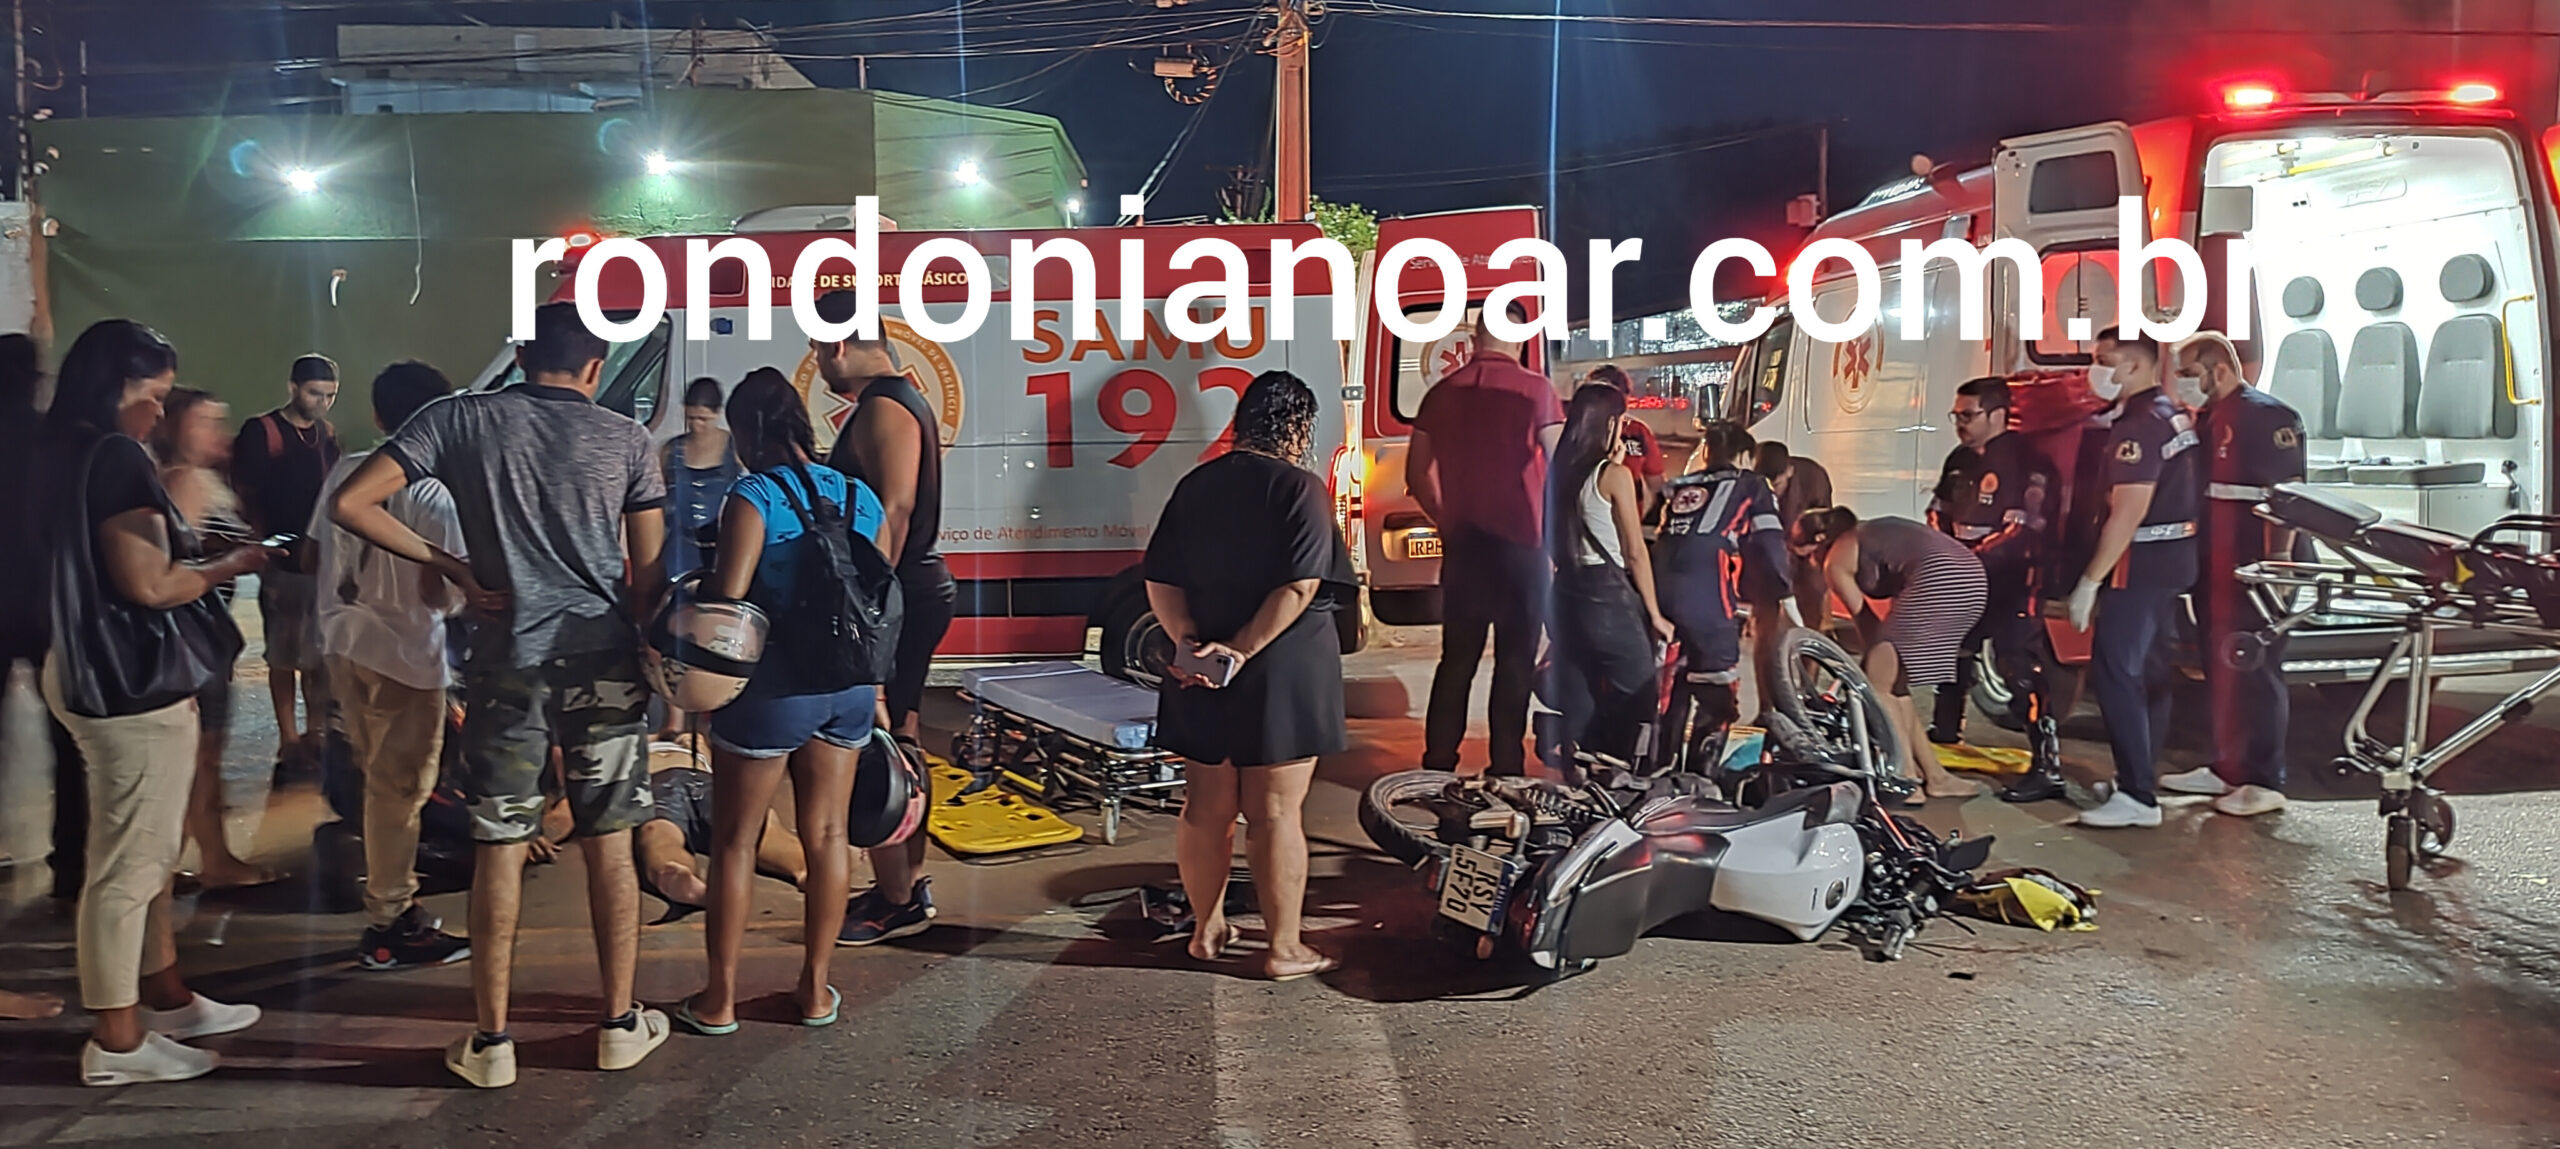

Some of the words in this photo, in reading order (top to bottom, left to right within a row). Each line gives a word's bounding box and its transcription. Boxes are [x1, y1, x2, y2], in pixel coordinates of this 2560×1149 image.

[820, 275, 840, 288] DE
[921, 271, 969, 286] ÁSICO
[1021, 306, 1266, 364] SAMU
[1026, 366, 1256, 470] 192
[974, 526, 993, 541] de
[996, 525, 1098, 541] Atendimento
[1102, 523, 1150, 538] Móvel
[1446, 857, 1478, 914] 5F70
[1469, 870, 1499, 916] RSY
